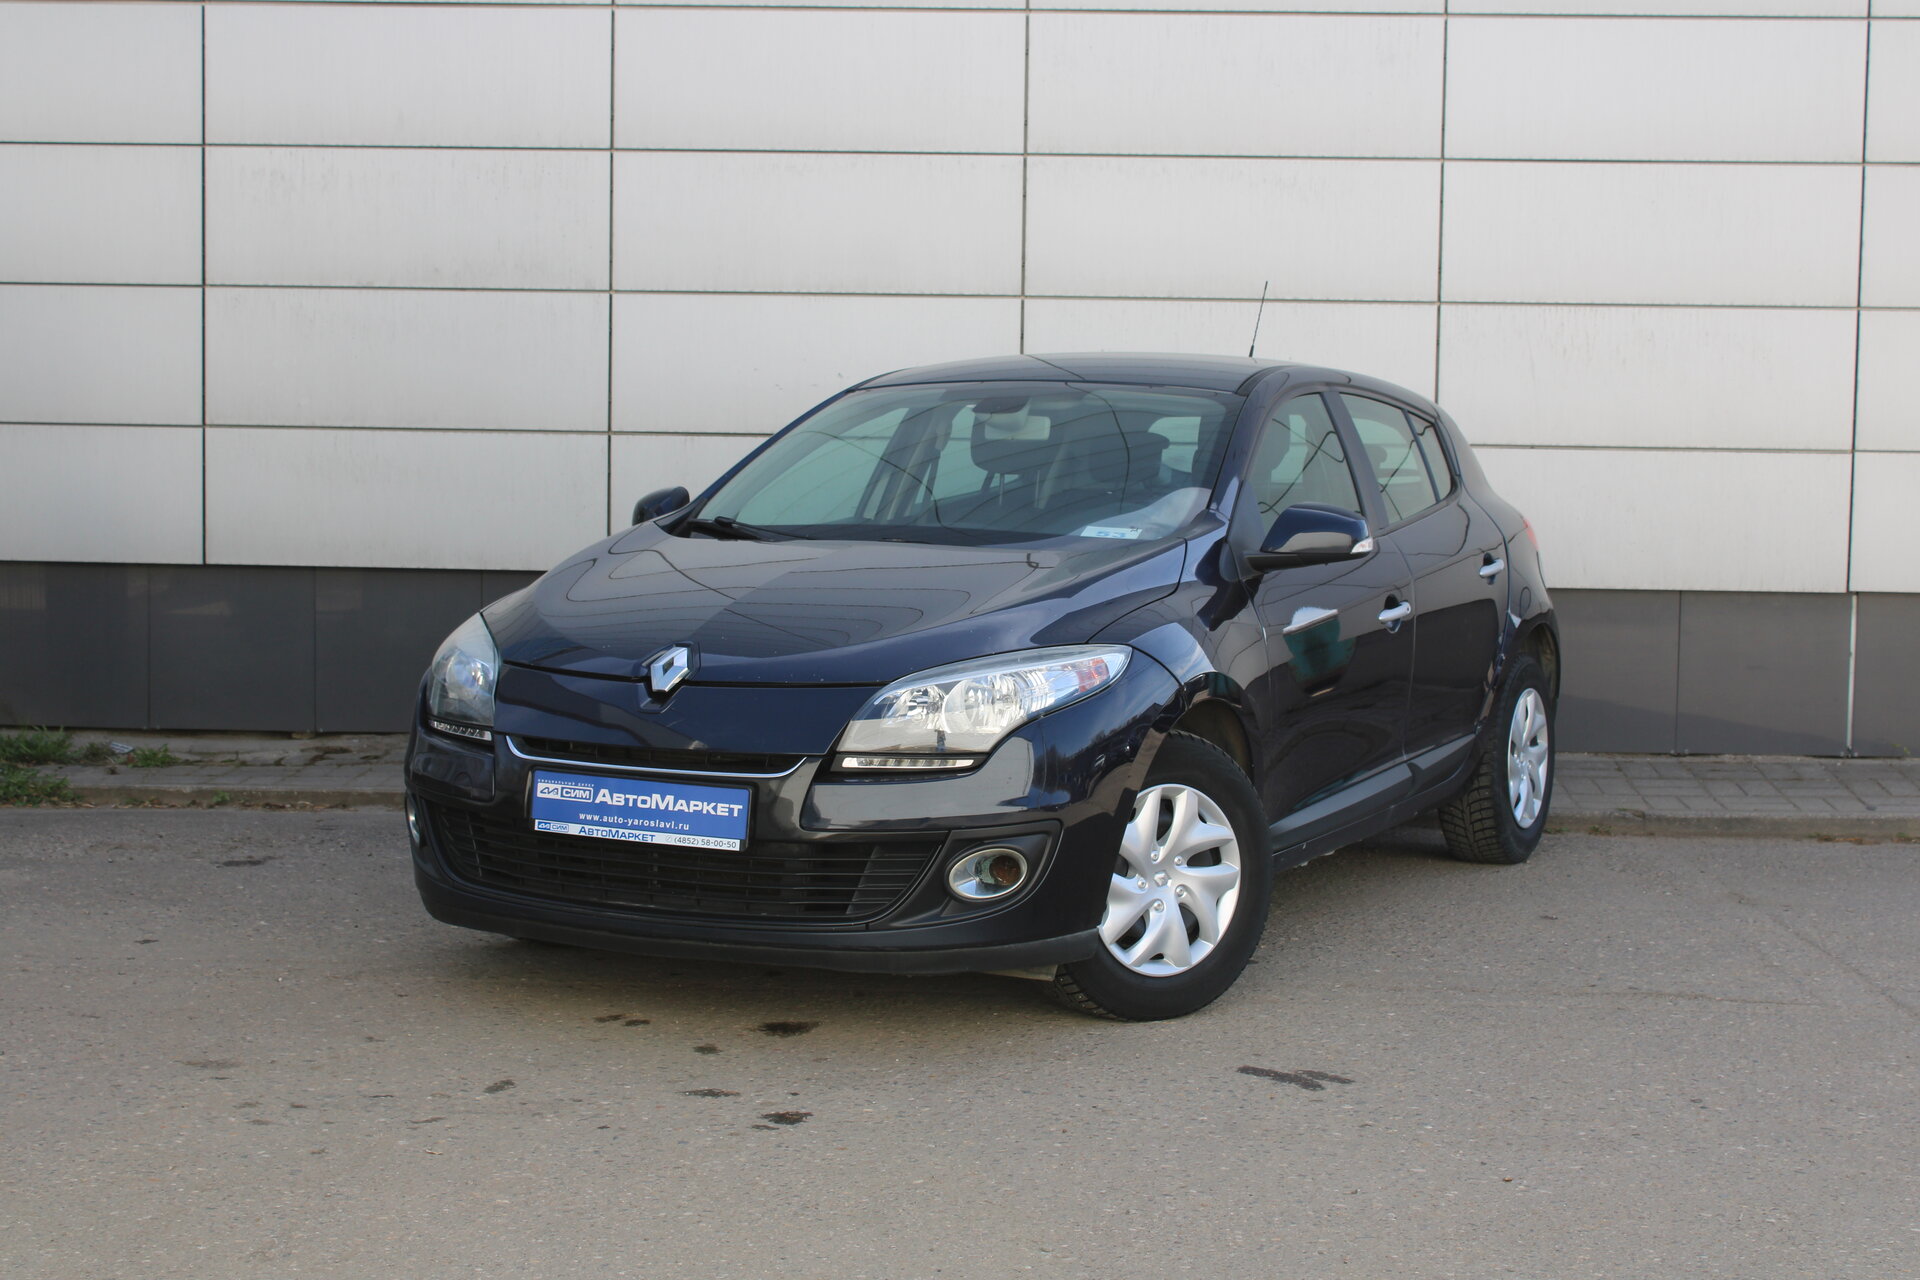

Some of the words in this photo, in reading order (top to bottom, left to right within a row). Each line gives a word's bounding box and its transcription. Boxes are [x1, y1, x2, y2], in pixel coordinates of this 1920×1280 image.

[562, 788, 590, 799] СИМ
[579, 813, 690, 831] www.auto-yaroslavl.ru
[674, 836, 699, 846] (4852)
[701, 839, 737, 849] 58-00-50
